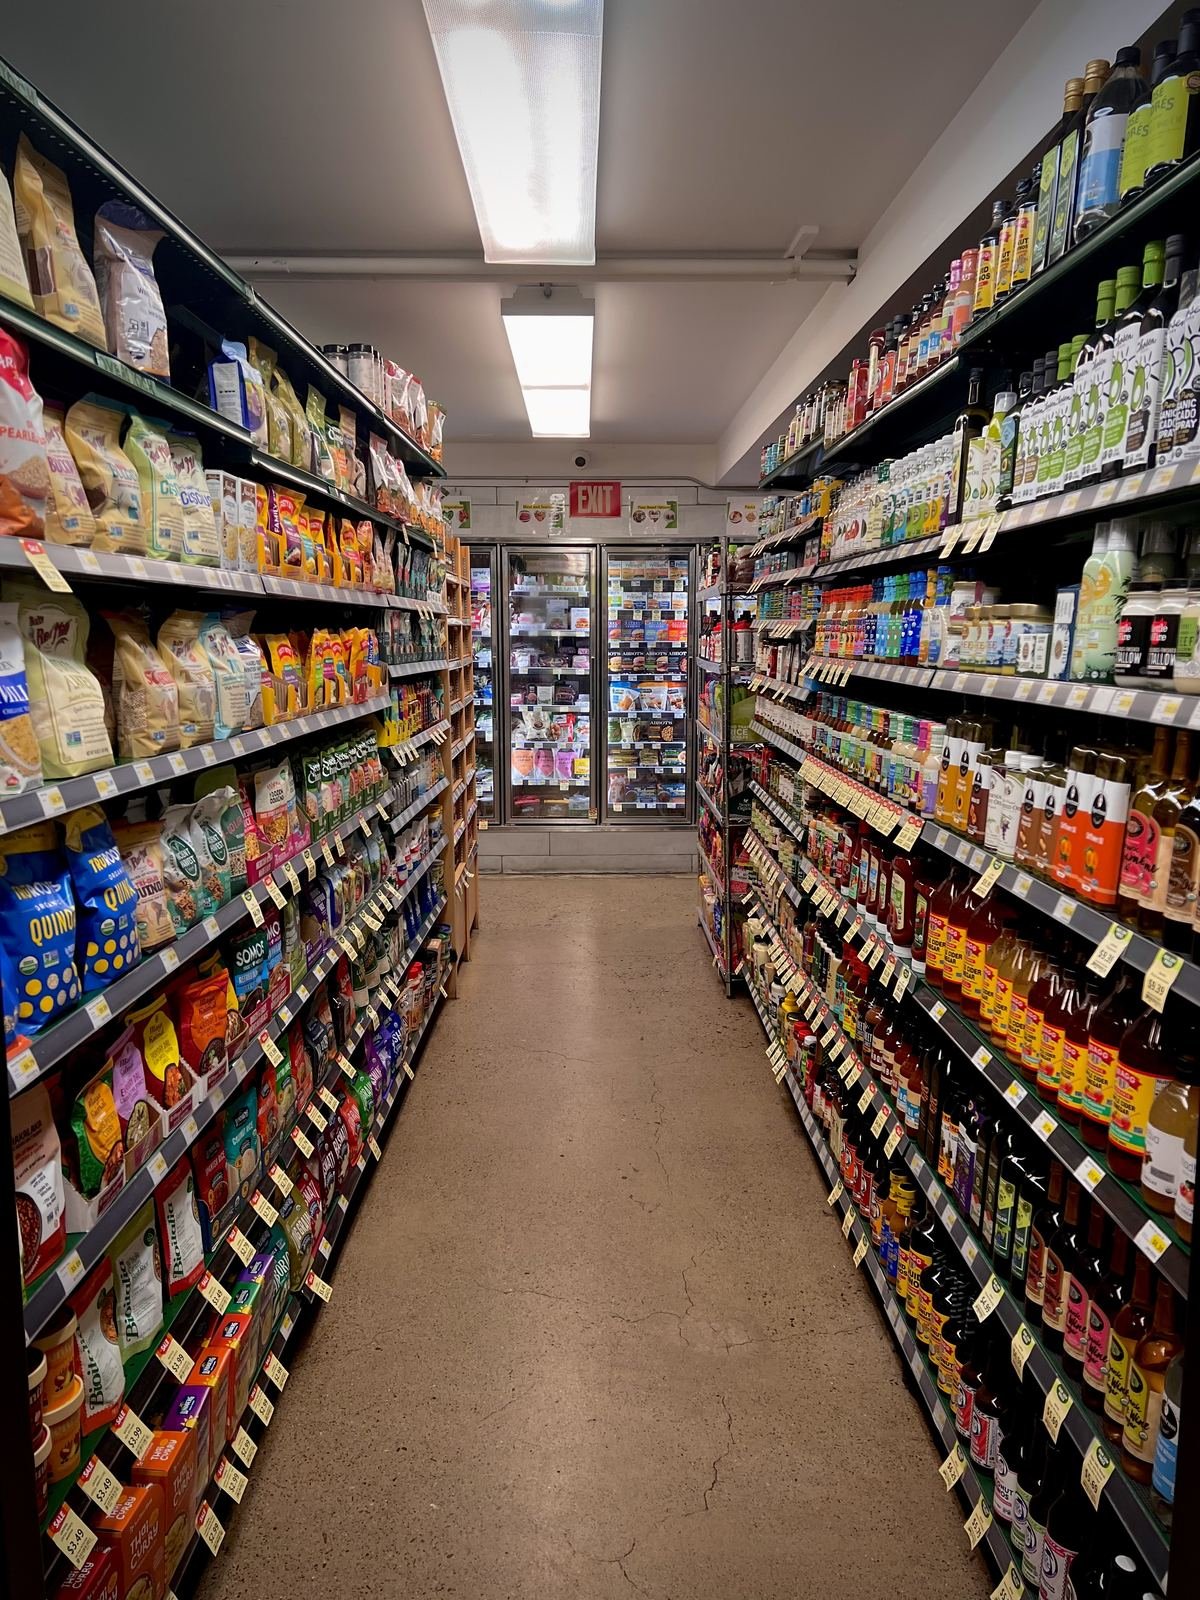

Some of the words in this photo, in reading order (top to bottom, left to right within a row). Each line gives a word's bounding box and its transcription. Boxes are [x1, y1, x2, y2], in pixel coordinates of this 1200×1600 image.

[578, 486, 613, 513] EXIT
[160, 1338, 170, 1351] SALE
[171, 1354, 185, 1373] $3.99
[115, 1411, 126, 1425] SALE
[1129, 1411, 1150, 1431] Wine
[128, 1427, 142, 1449] $3.99
[160, 1439, 177, 1461] CURRY
[83, 1462, 94, 1478] SALE
[96, 1478, 112, 1502] $3.49
[52, 1509, 66, 1529] SALE
[116, 1496, 136, 1520] CURRY
[67, 1528, 84, 1555] $3.49
[72, 1561, 94, 1589] CURRY
